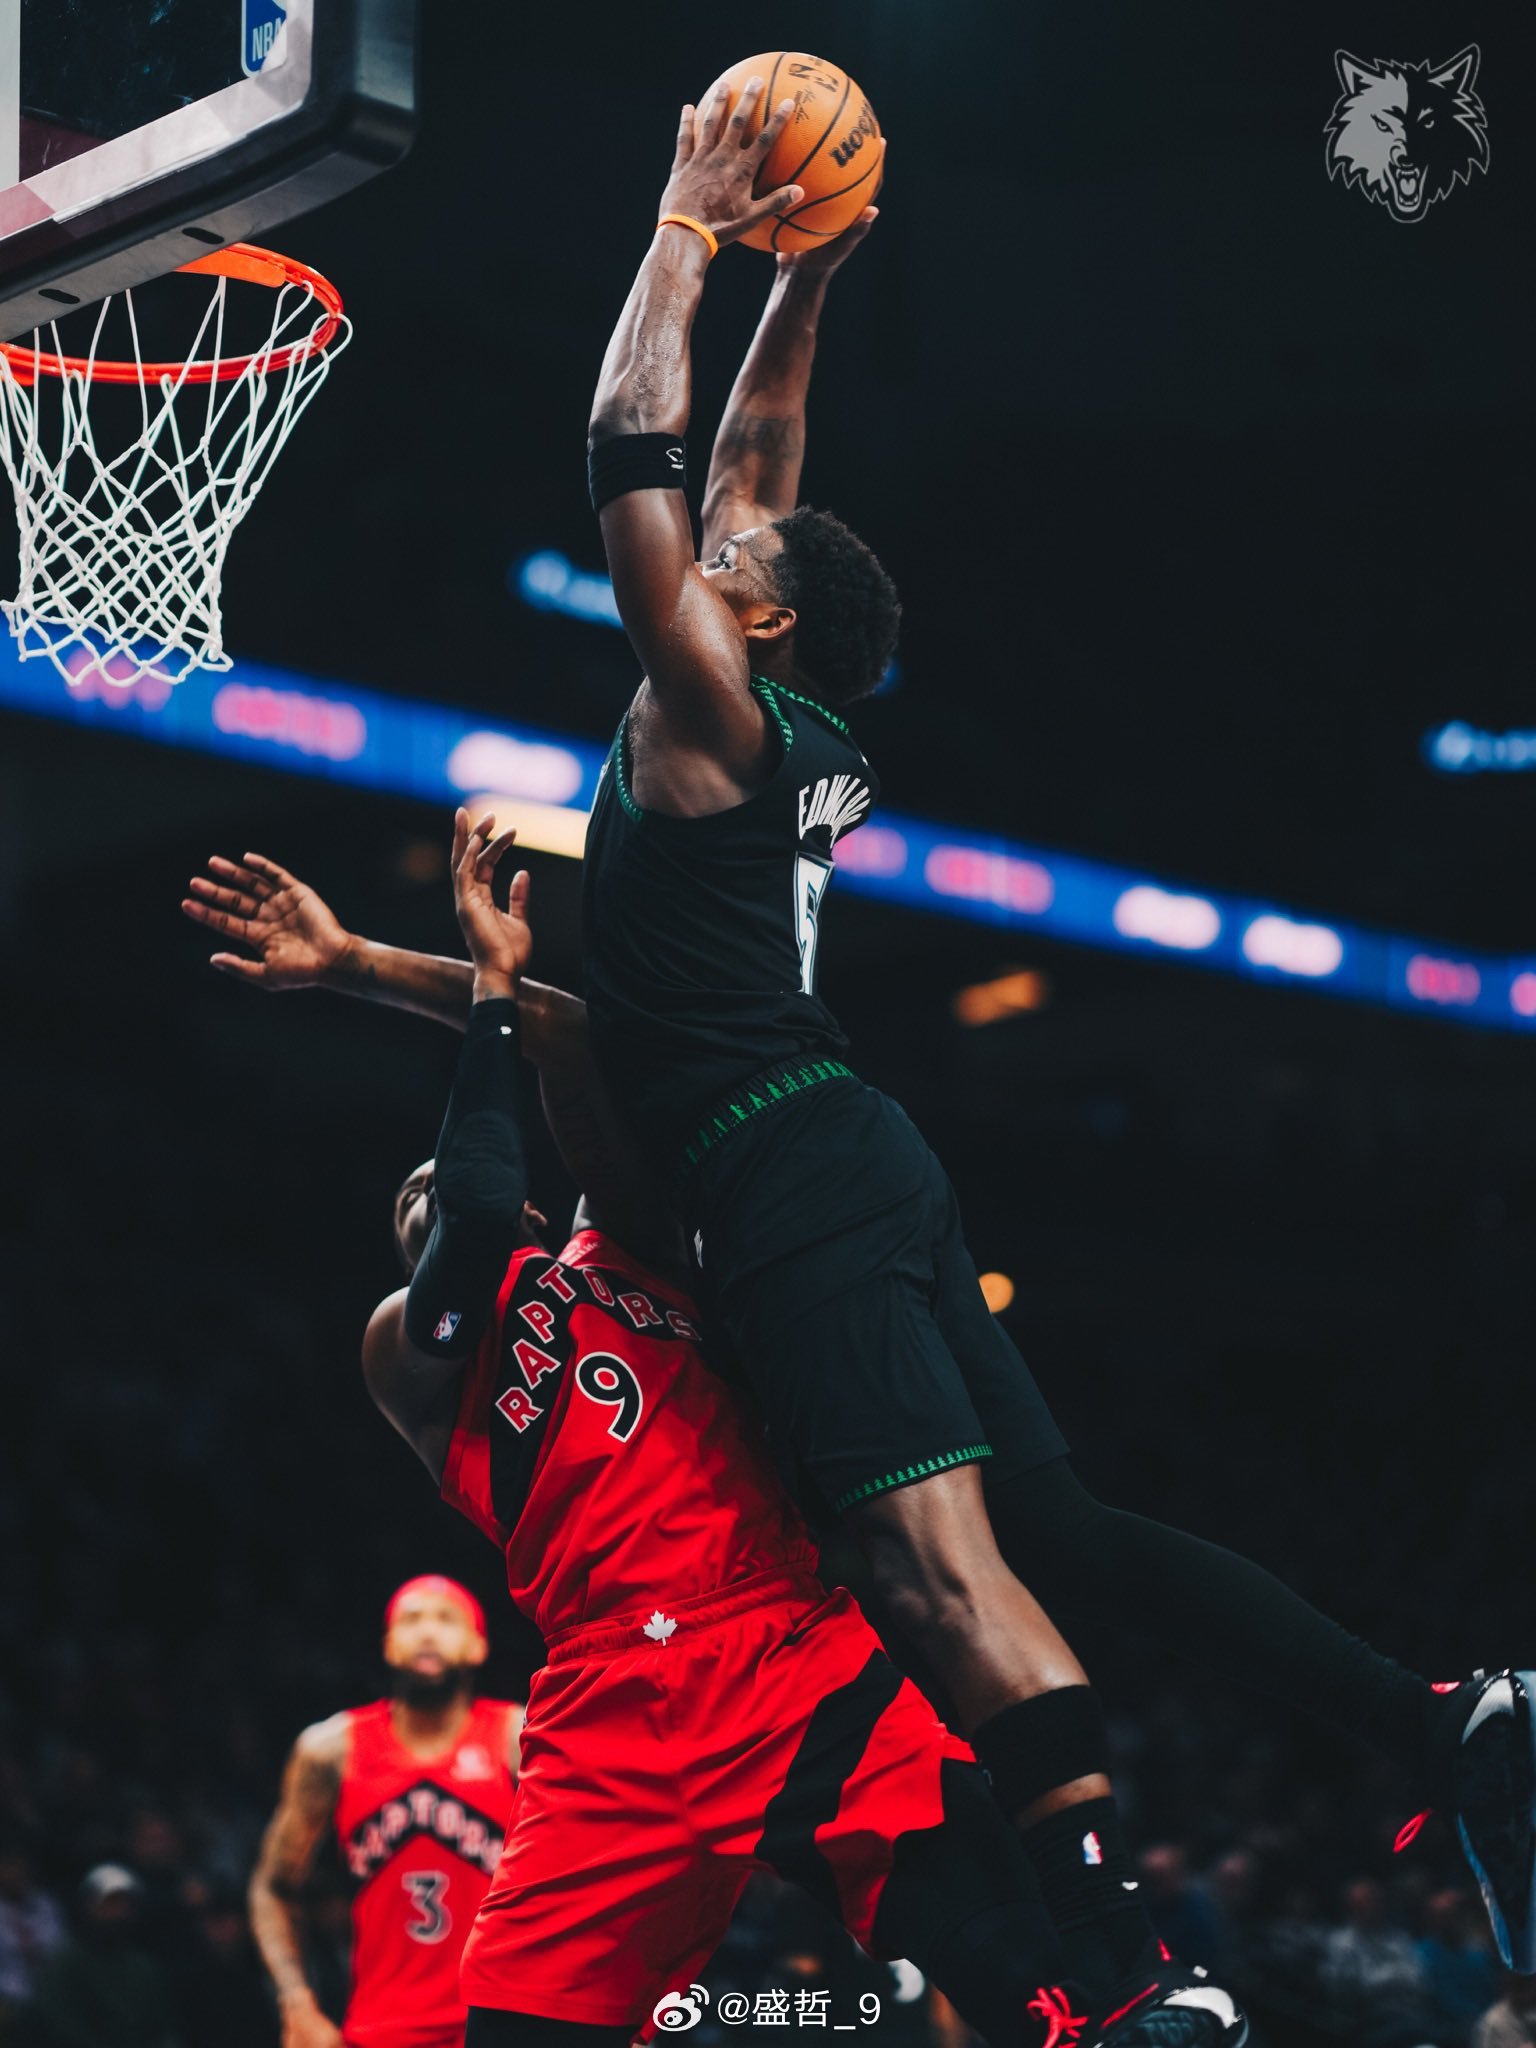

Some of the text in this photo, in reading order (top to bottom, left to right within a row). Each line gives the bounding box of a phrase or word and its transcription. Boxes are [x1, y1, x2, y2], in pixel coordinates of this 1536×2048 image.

[793, 851, 836, 996] 5
[495, 1262, 702, 1434] RAPTORS
[575, 1352, 643, 1443] 9
[401, 1869, 453, 1946] 3
